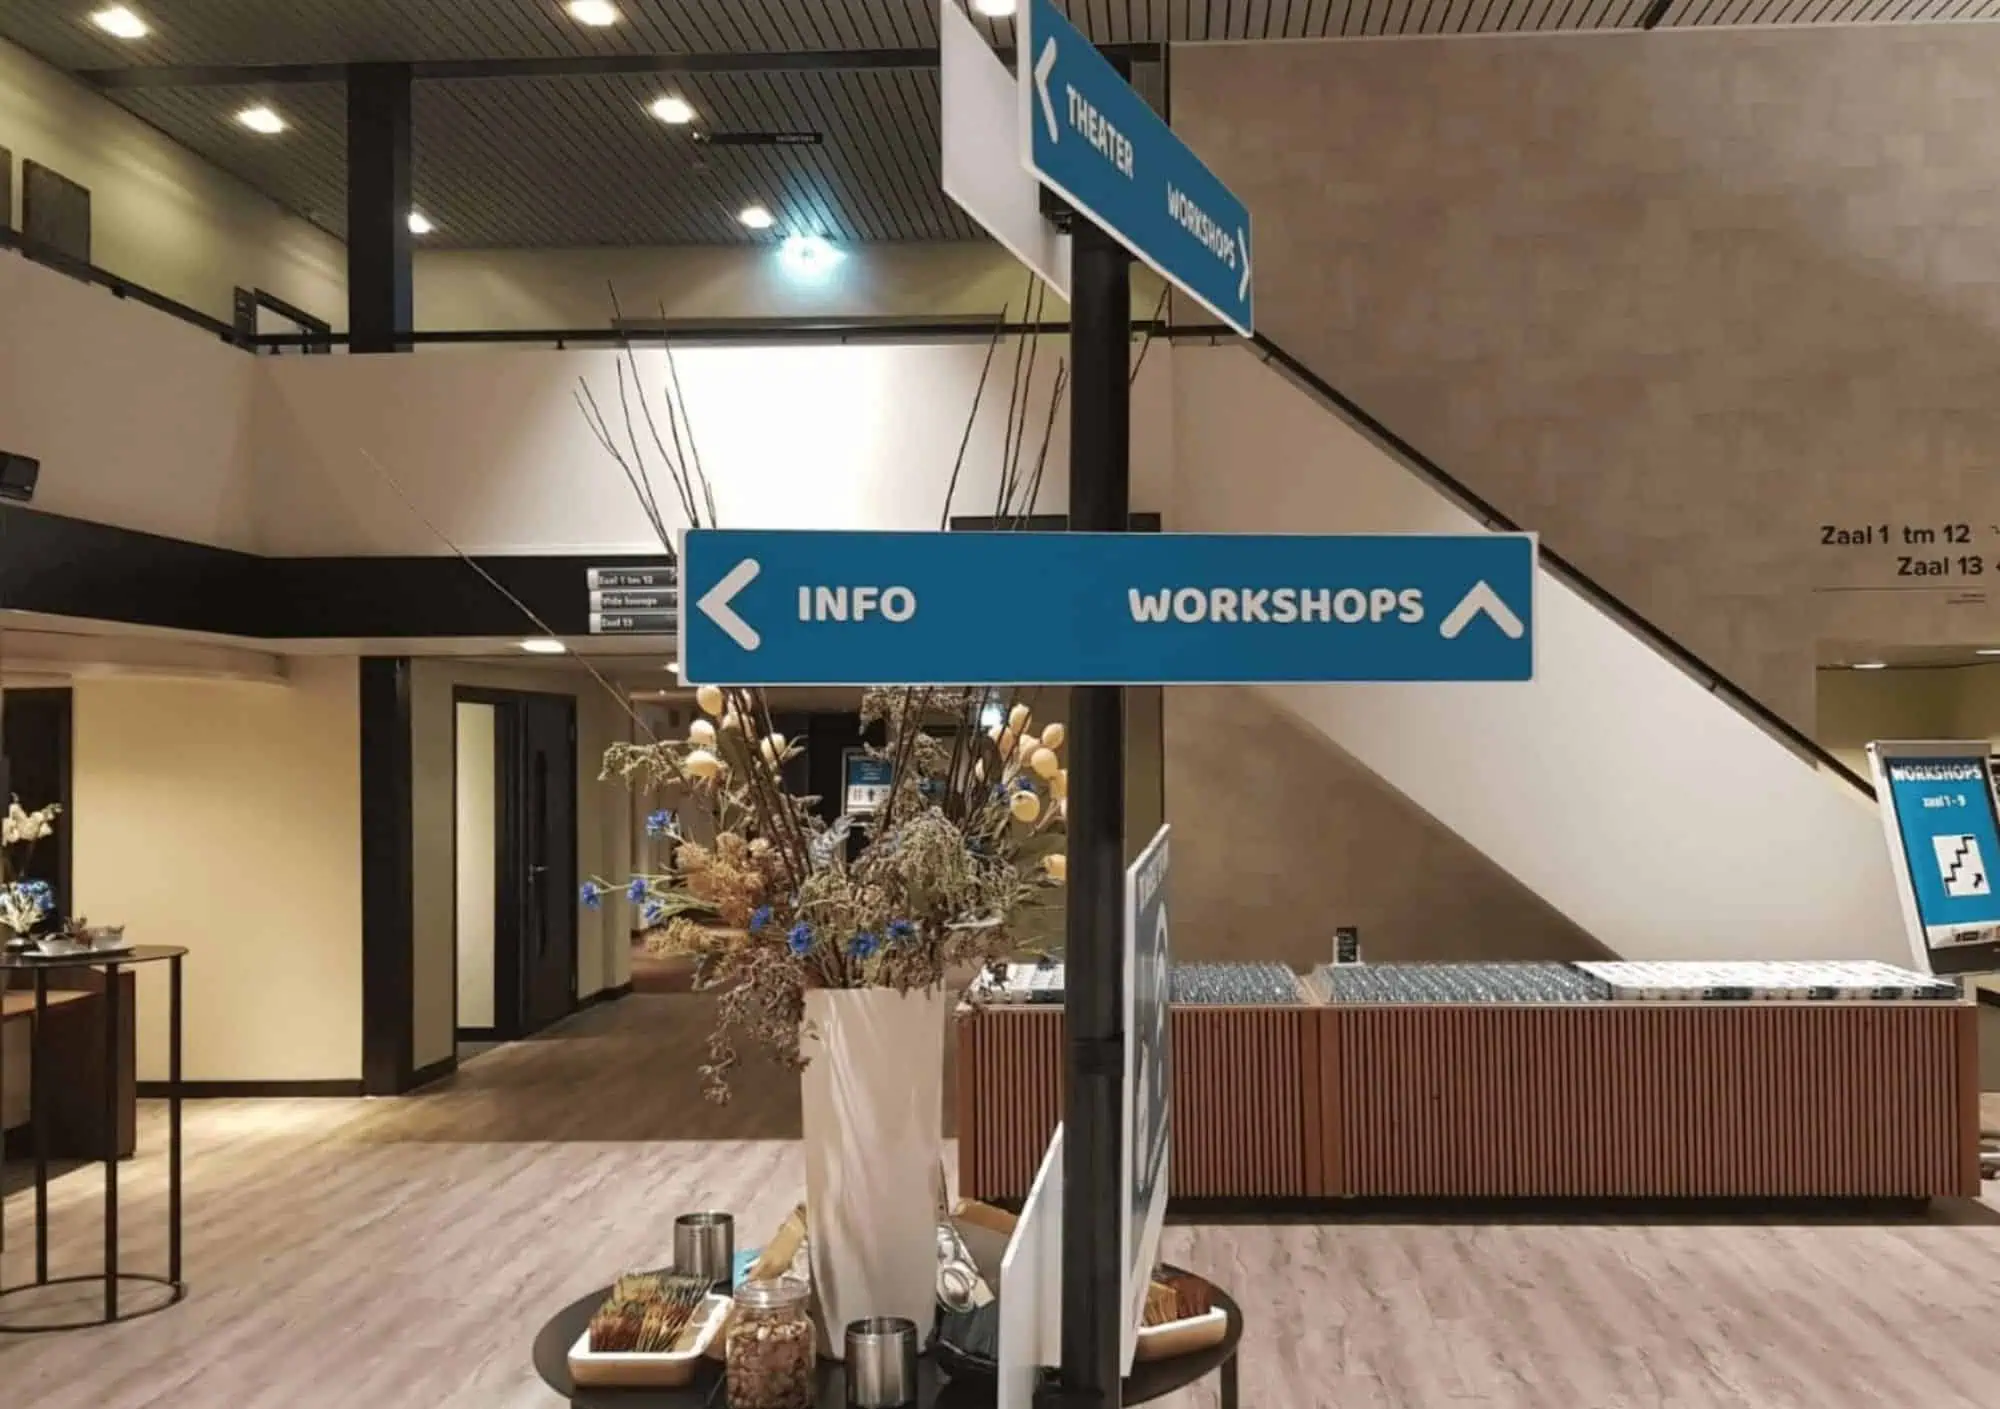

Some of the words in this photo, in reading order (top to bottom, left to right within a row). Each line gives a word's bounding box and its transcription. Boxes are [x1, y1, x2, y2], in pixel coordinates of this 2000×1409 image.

[1066, 83, 1133, 180] THEATER
[1167, 181, 1236, 270] WORKSHOPS
[1820, 525, 1872, 545] Zaal
[1877, 525, 1890, 545] 1
[1903, 525, 1935, 545] tm
[1943, 524, 1971, 544] 12
[1897, 556, 1949, 576] Zaal
[1958, 556, 1984, 576] 13
[798, 585, 916, 622] INFO
[1128, 587, 1424, 623] WORKSHOPS
[1891, 764, 1983, 781] WORKSHOPS
